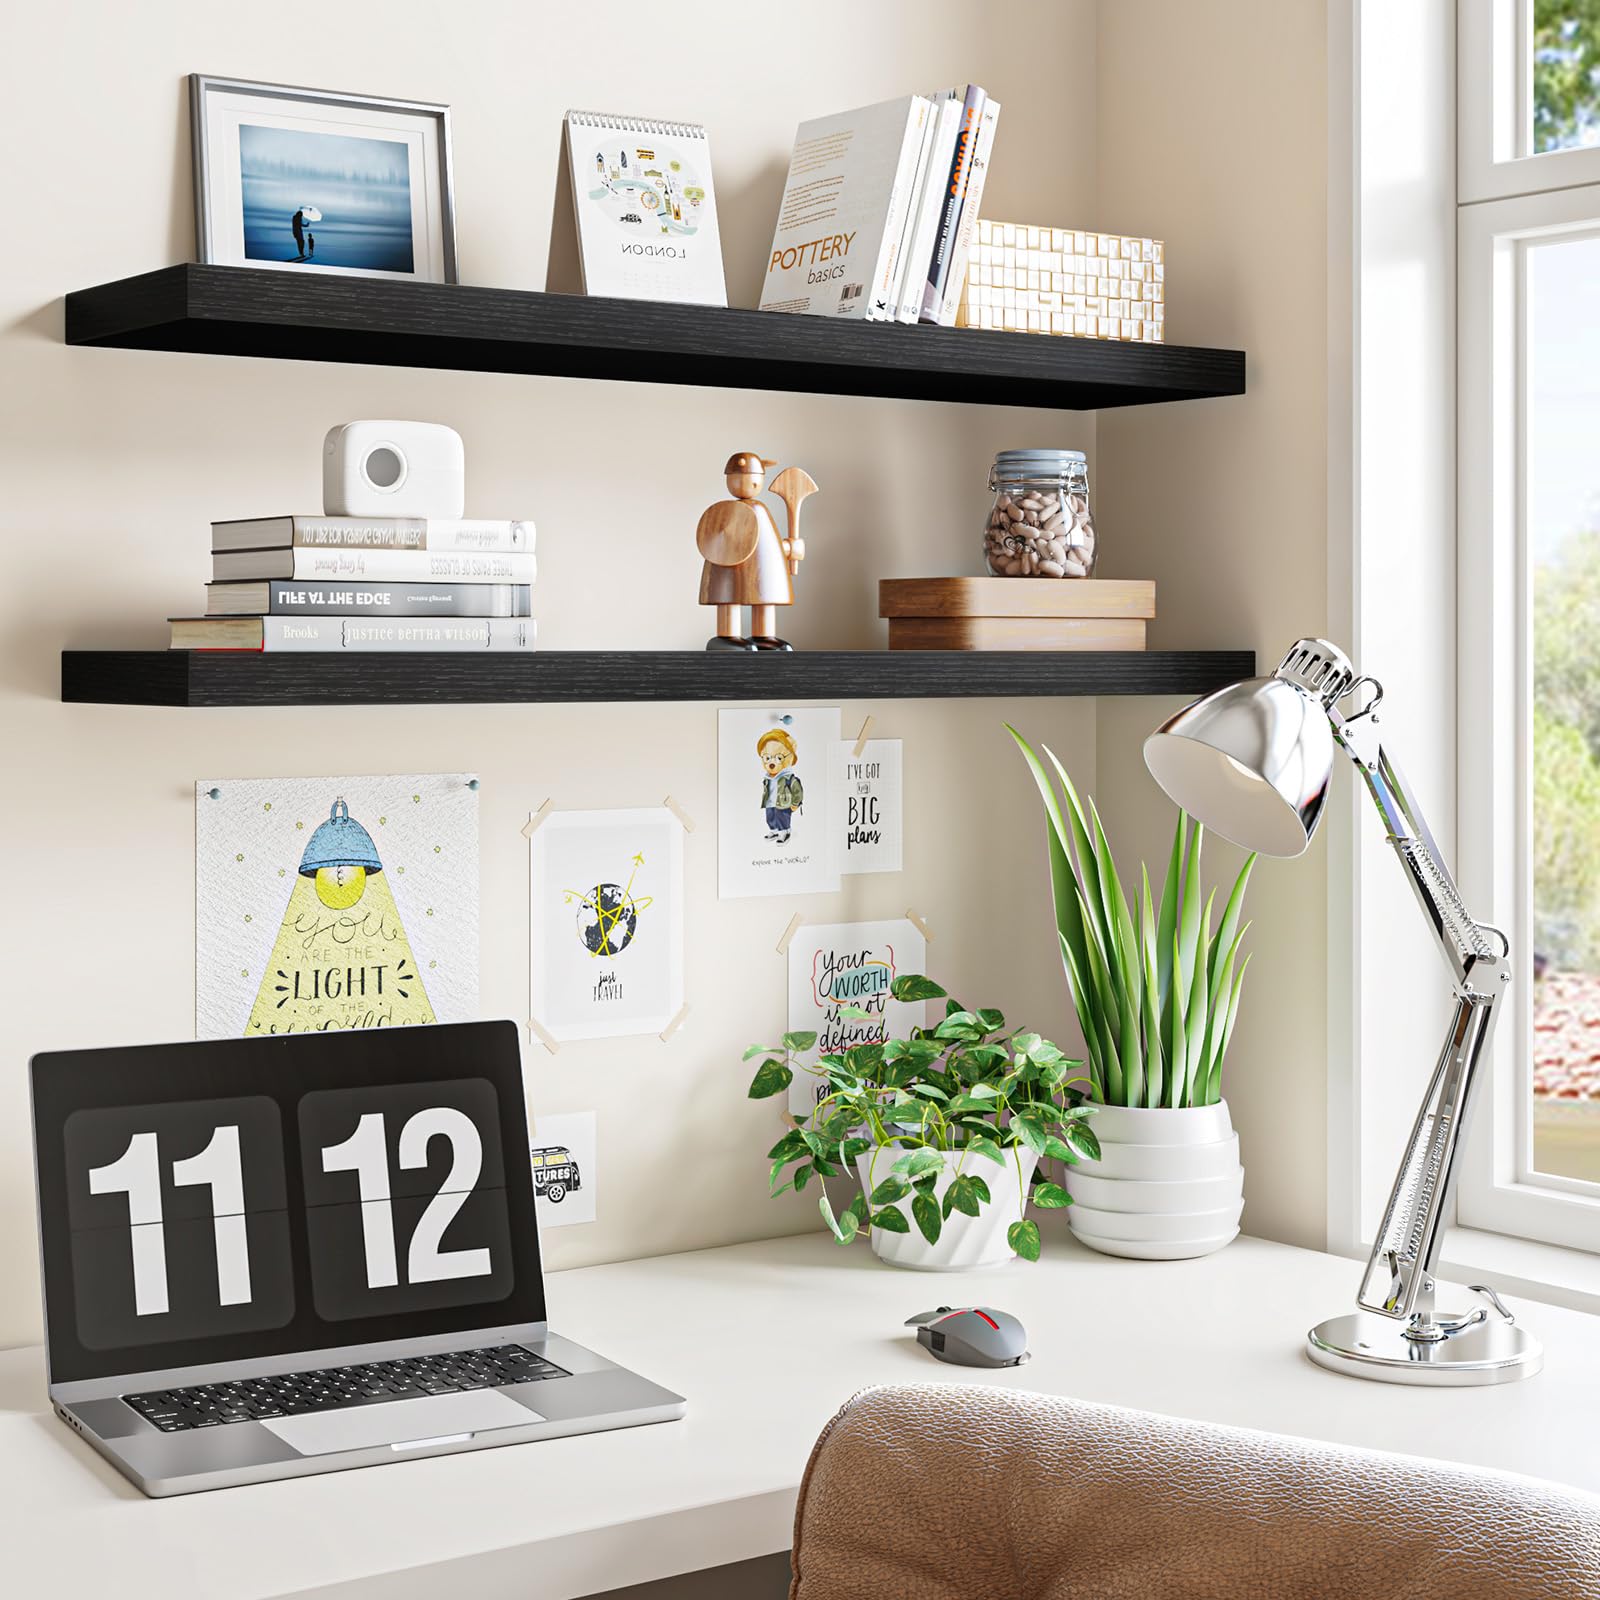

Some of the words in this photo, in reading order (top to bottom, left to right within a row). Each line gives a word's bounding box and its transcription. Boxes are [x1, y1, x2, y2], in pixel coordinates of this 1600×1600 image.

[769, 231, 857, 273] POTTERY
[807, 263, 846, 285] basics
[283, 624, 319, 639] Brooks
[847, 764, 862, 779] I'VE
[865, 763, 880, 779] GOT
[848, 796, 881, 825] BIG
[847, 825, 882, 850] plans
[283, 911, 405, 950] you
[301, 948, 331, 962] ARE
[345, 945, 375, 960] THE
[294, 965, 389, 1000] LIGHT
[593, 983, 623, 1001] TRAVEL
[834, 967, 889, 999] WORTH
[308, 1004, 324, 1016] OF
[340, 1002, 365, 1013] THE
[820, 1018, 890, 1055] defined
[88, 1124, 253, 1316] 11
[320, 1106, 493, 1289] 12
